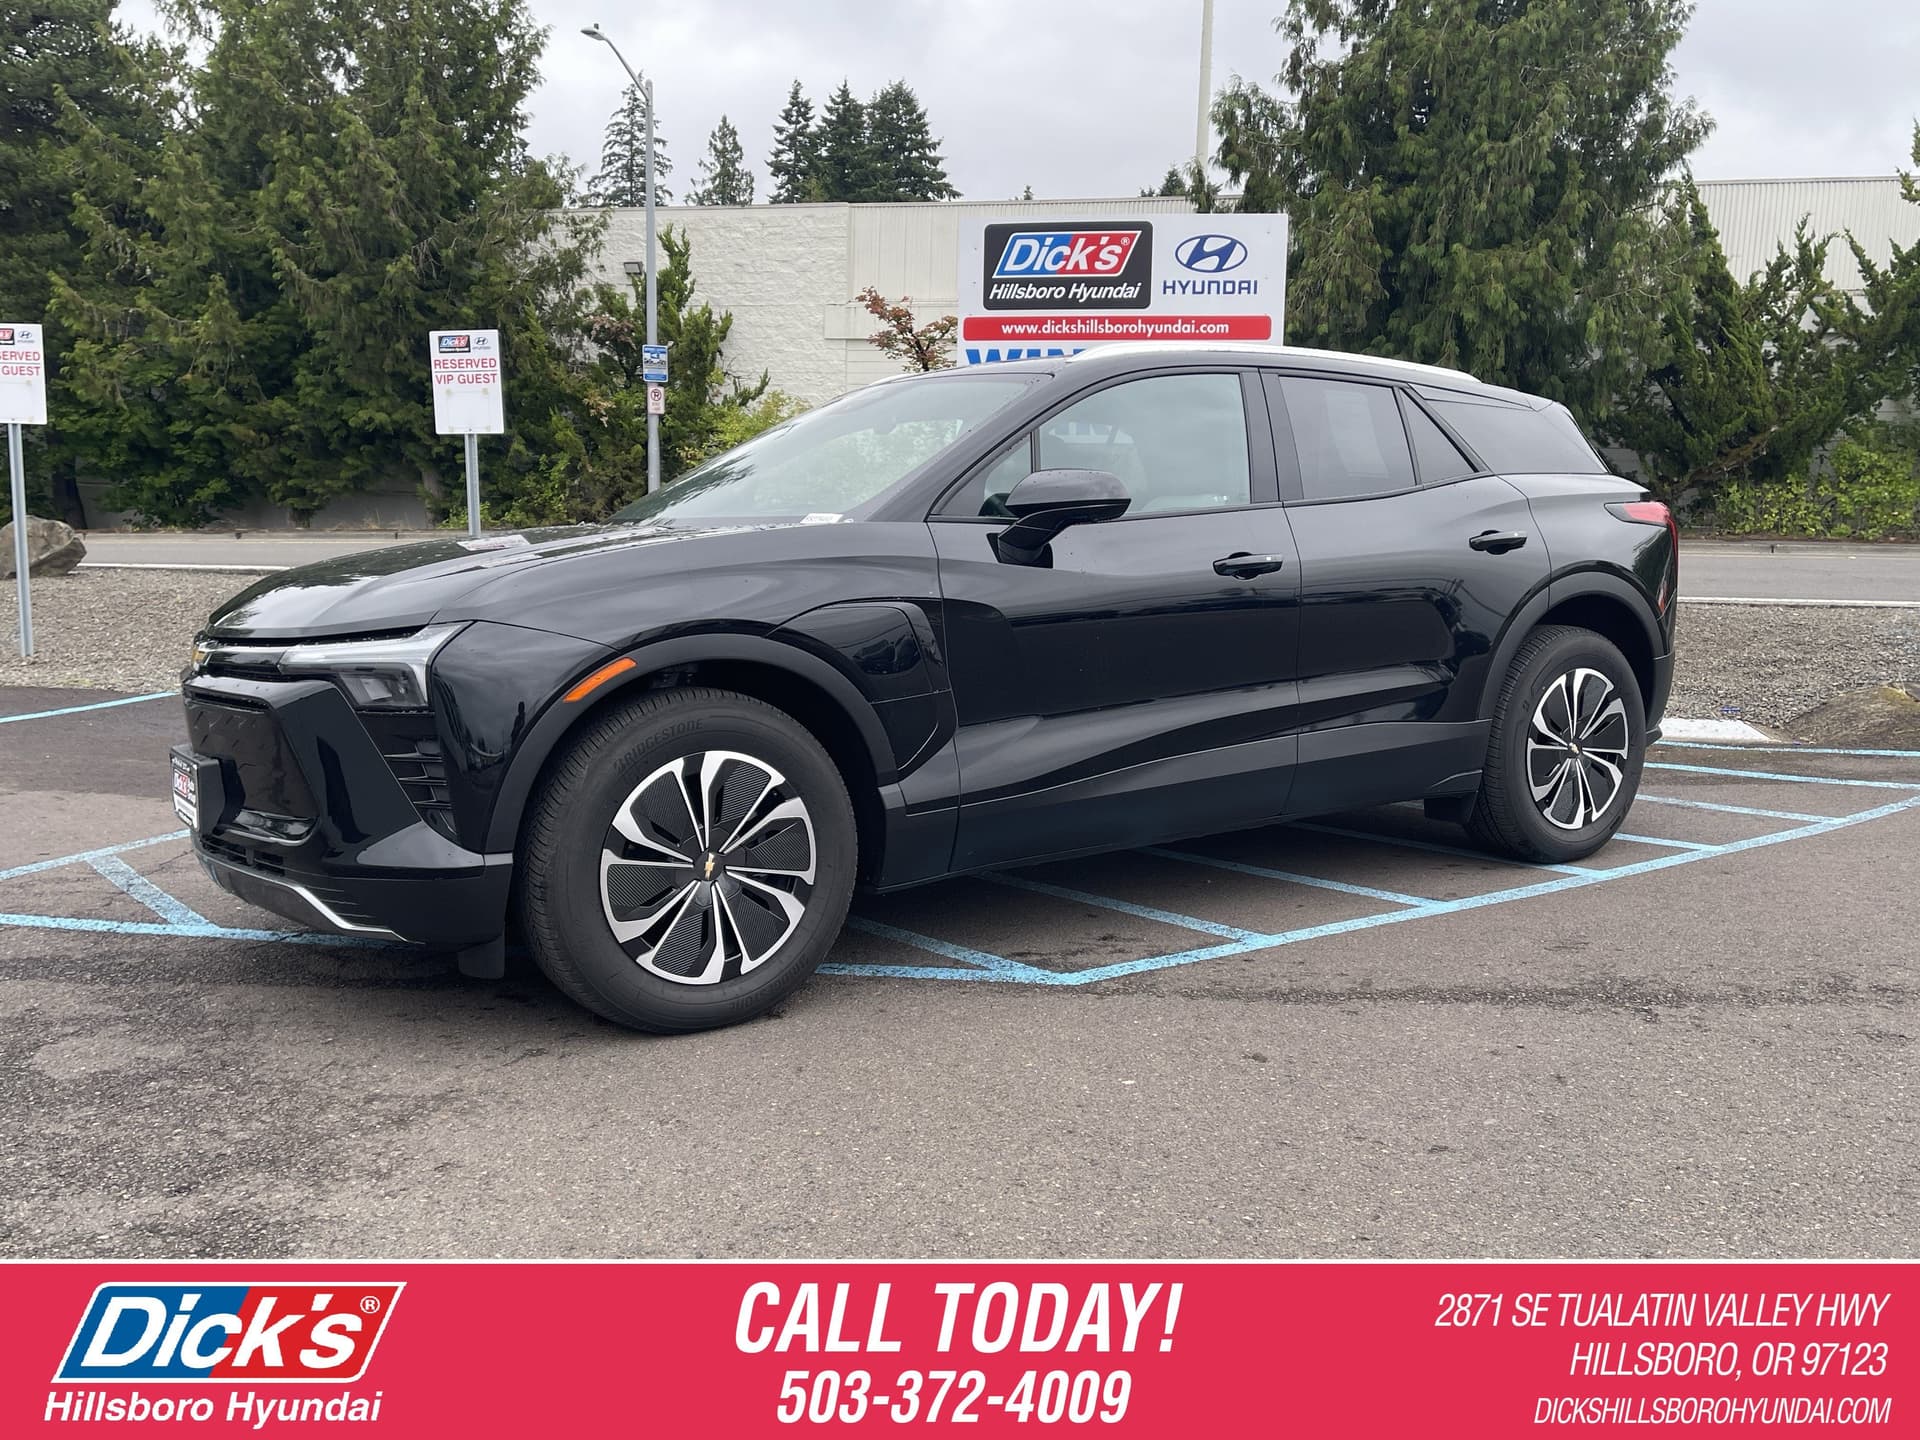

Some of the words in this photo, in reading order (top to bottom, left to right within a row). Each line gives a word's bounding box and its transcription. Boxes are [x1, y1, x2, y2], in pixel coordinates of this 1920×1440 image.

[1003, 235, 1124, 272] Dick's
[989, 282, 1067, 301] Hillsboro
[1070, 282, 1142, 303] Hyundai
[1162, 279, 1258, 296] HYUNDAI
[1001, 318, 1230, 339] www.dickshillsborohyundai.com
[0, 350, 41, 361] ERVED
[1, 365, 41, 376] GUEST
[433, 358, 497, 370] RESERVED
[435, 374, 454, 385] VIP
[457, 373, 498, 384] GUEST
